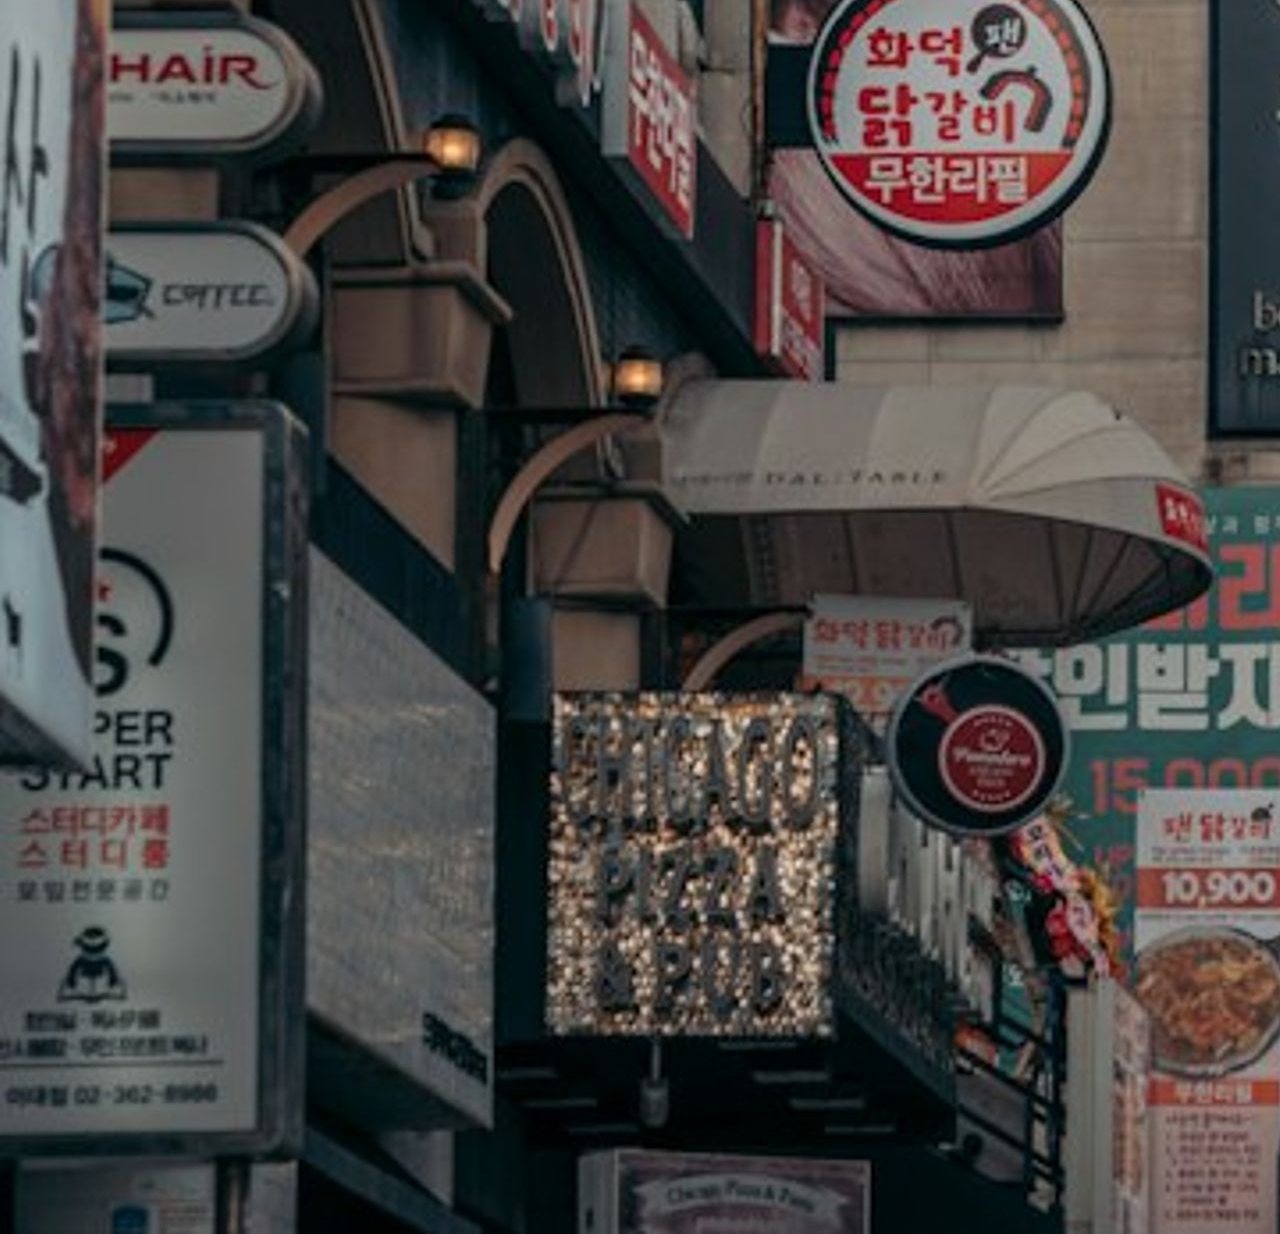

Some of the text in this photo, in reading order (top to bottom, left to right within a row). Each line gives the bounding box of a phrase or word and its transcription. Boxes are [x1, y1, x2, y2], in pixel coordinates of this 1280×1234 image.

[866, 27, 965, 77] 화덕
[857, 84, 1017, 148] 닭갈비
[865, 154, 1029, 205] 무한리필
[18, 803, 171, 839] 스터디카페
[1162, 871, 1276, 909] 10,900
